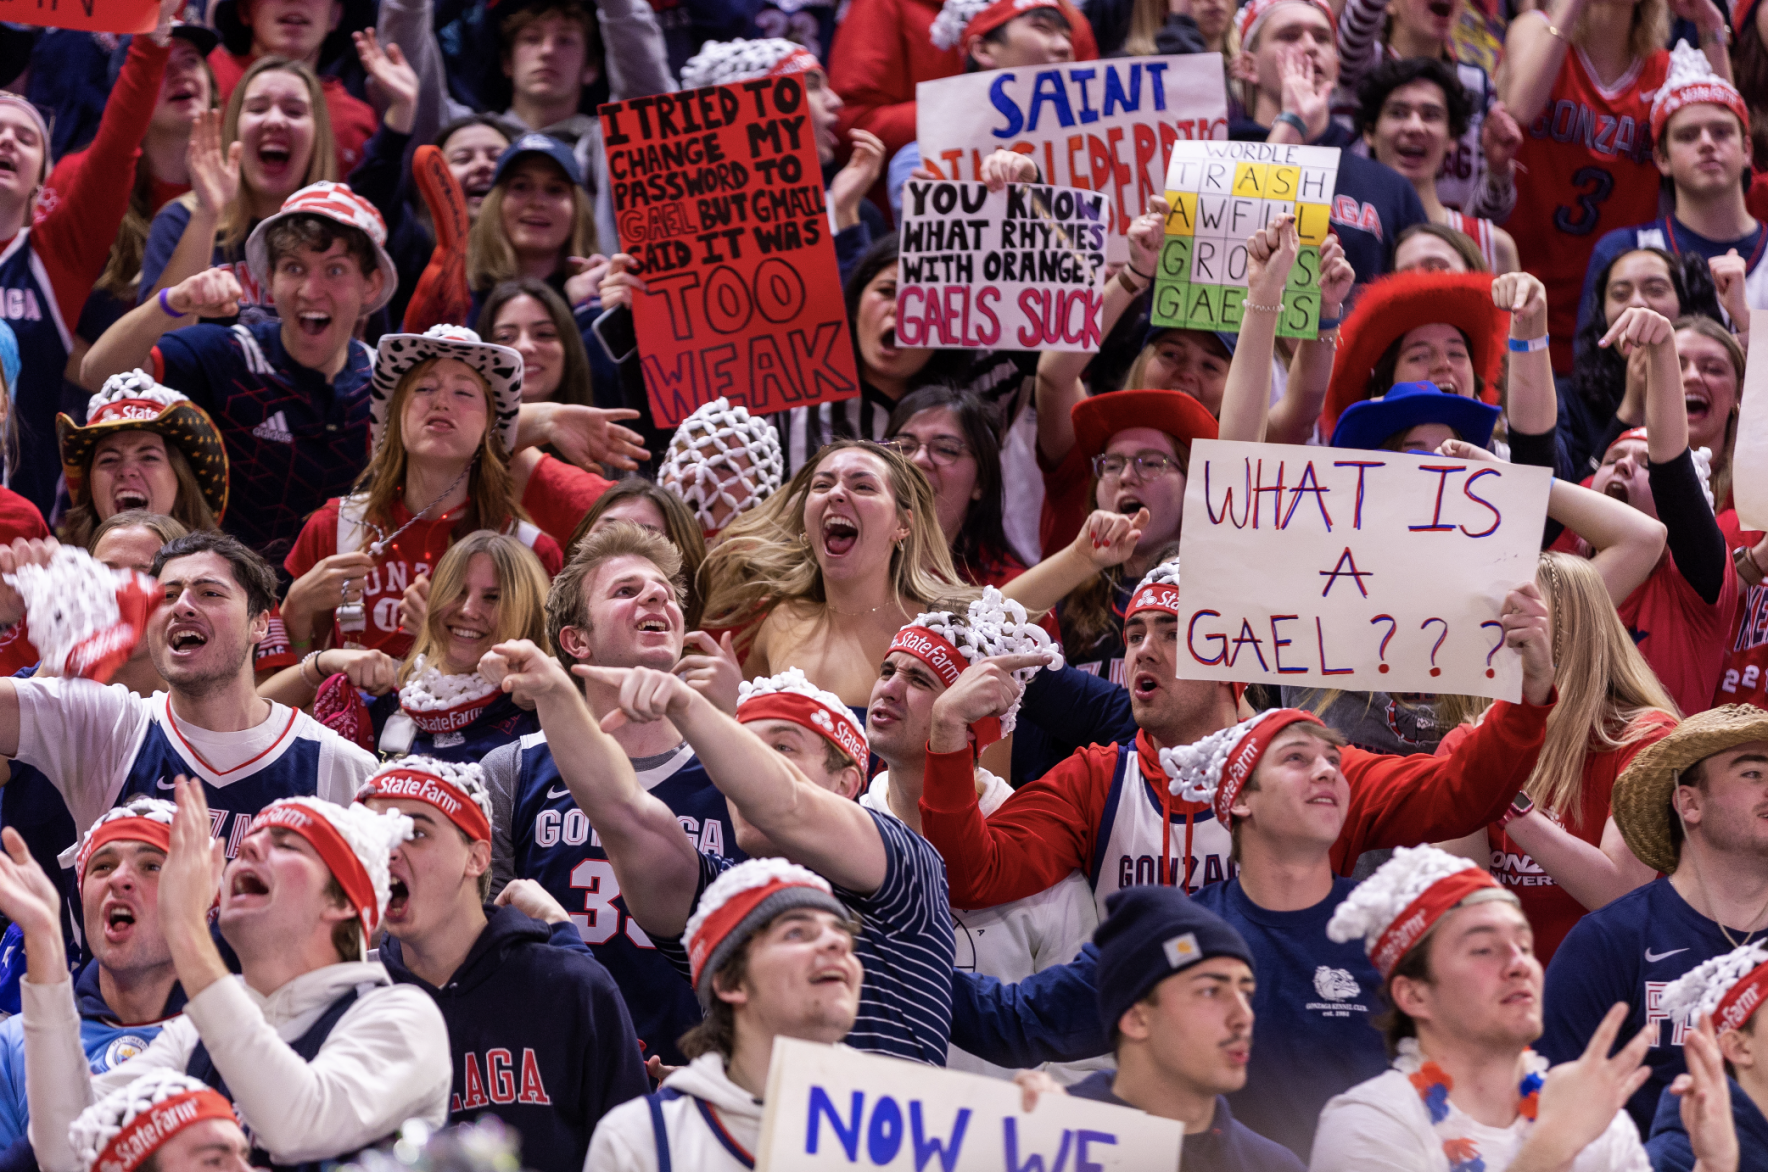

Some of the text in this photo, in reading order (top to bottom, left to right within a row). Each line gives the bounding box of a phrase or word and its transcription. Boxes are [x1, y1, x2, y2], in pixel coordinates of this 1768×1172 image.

[600, 76, 801, 147] I TRIED TO
[988, 62, 1168, 139] SAINT
[609, 115, 806, 181] CHANGE MY
[1205, 142, 1299, 165] WORDLE
[613, 154, 803, 212] PASSWORD TO
[908, 181, 1104, 221] YOU KNOW
[1173, 161, 1326, 199] TRASH
[1554, 166, 1615, 236] 3
[618, 184, 828, 244] GAEL BUT GMAIL
[903, 218, 1106, 253] WHAT RHYMES
[624, 218, 820, 276] SAID IT WAS
[902, 250, 1105, 287] WITH ORANGE?
[1162, 240, 1315, 288] GROS
[644, 256, 807, 341] TOO
[897, 285, 1103, 350] GAELS SUCK
[1157, 285, 1314, 331] GAES
[640, 320, 857, 425] WEAK
[252, 427, 293, 444] adidas
[1204, 456, 1503, 539] WHAT IS
[1319, 546, 1375, 600] A
[896, 630, 962, 684] StateFarm
[377, 776, 459, 814] StateFarm
[114, 1099, 199, 1169] StateFarm
[805, 1085, 1119, 1172] NOW WE
